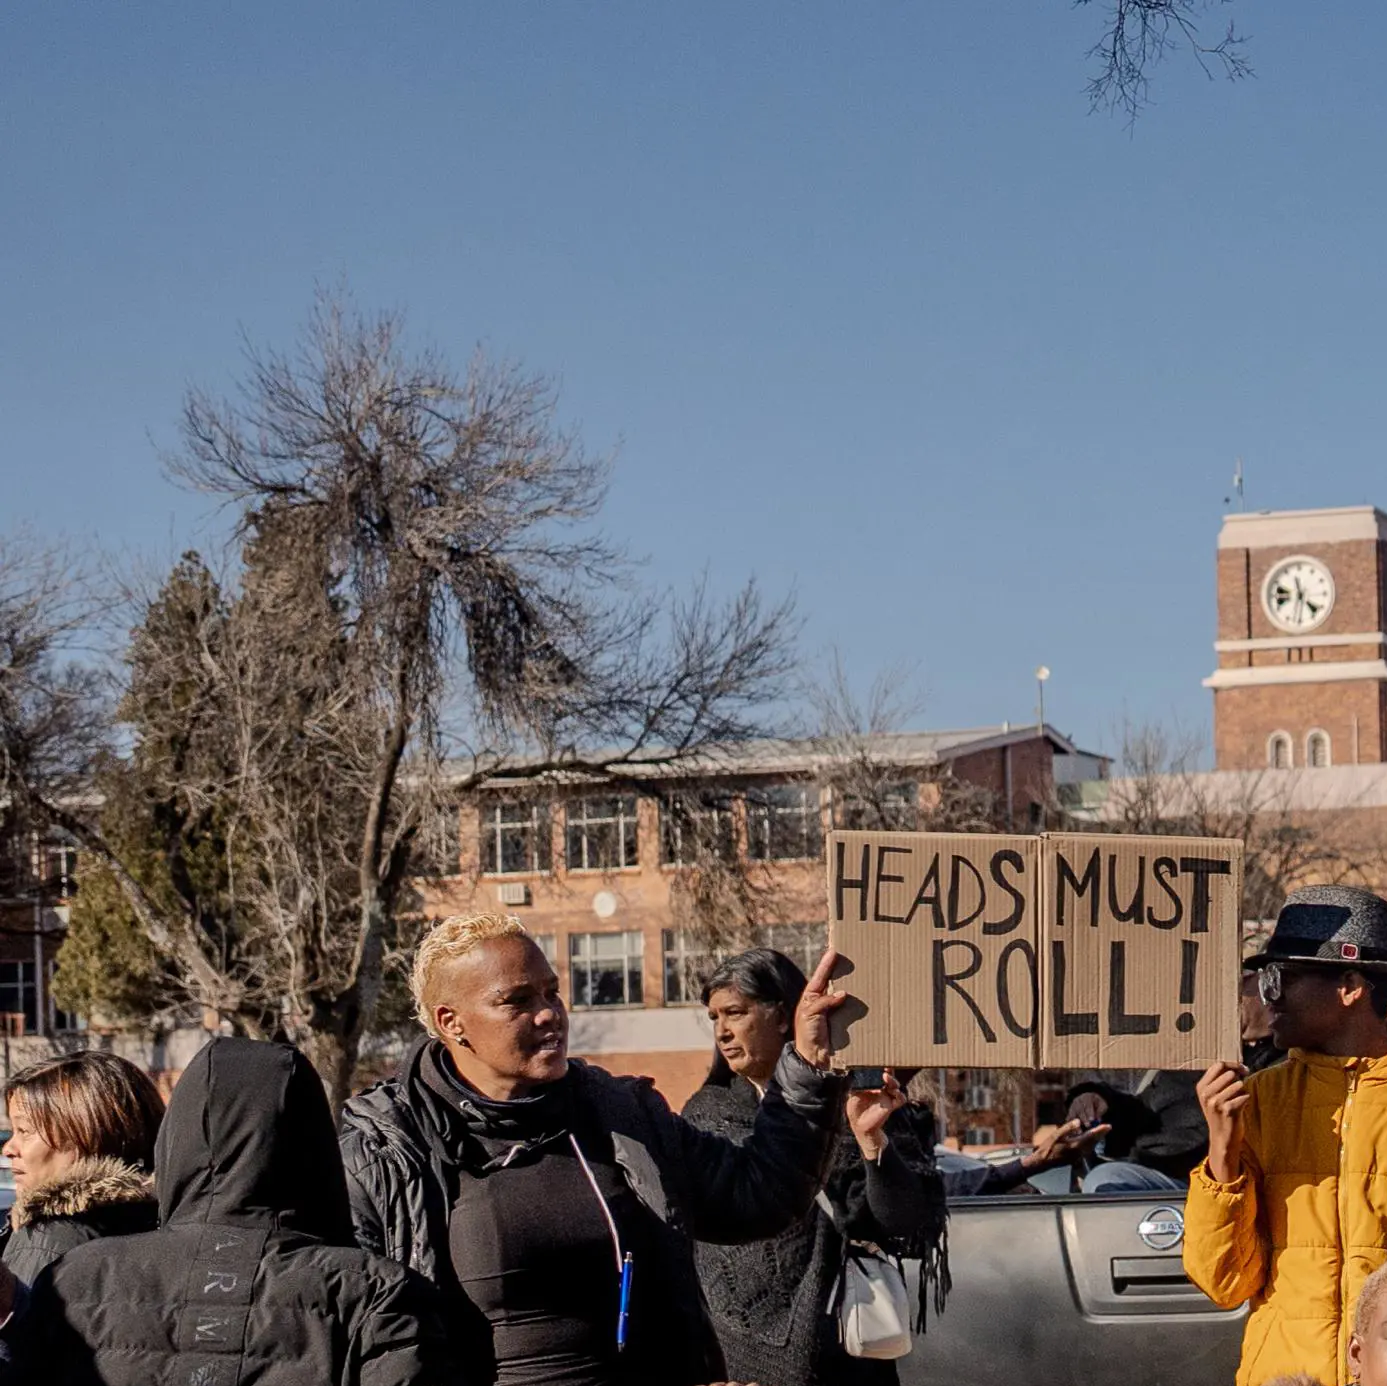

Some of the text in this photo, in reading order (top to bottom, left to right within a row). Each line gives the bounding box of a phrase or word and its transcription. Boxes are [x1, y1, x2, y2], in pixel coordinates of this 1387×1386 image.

[836, 841, 1231, 936] HEADS MUST
[932, 938, 1199, 1045] ROLL!
